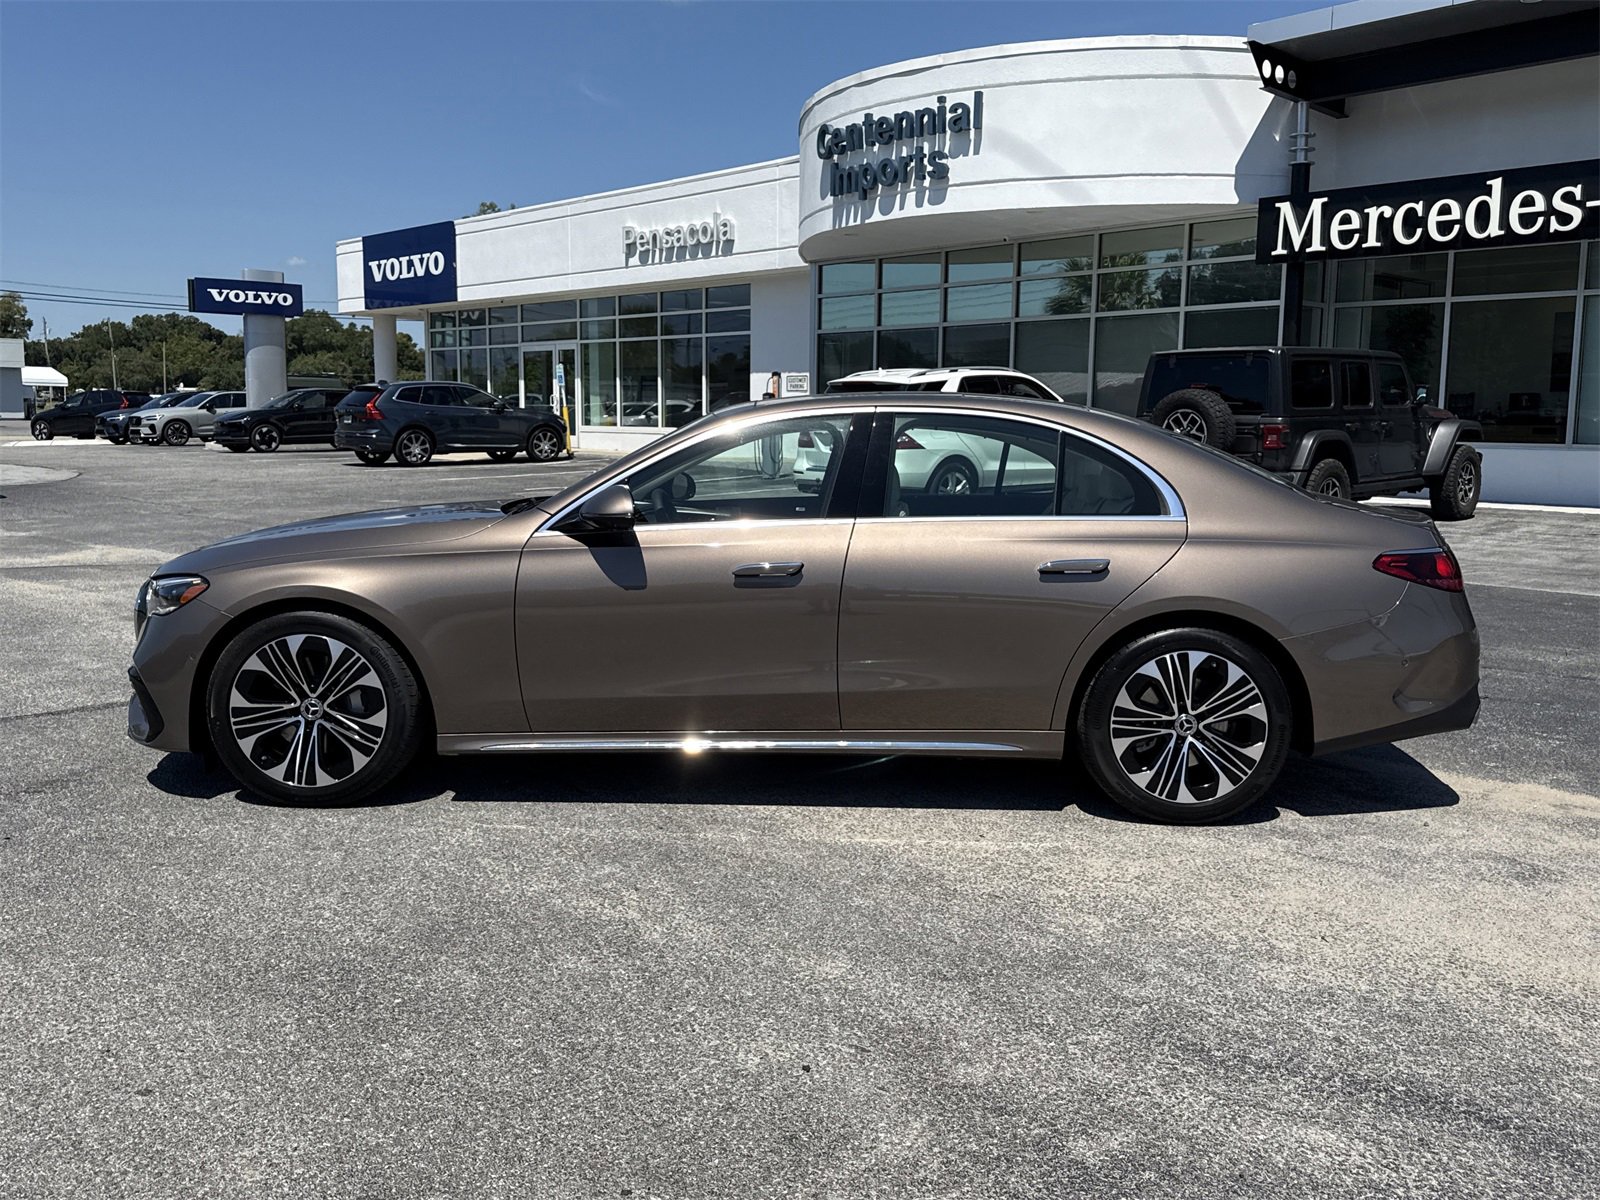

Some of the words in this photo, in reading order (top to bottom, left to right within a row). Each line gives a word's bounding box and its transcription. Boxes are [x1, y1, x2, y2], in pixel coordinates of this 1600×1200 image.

[817, 91, 984, 160] Centennial
[830, 146, 950, 200] Imports
[622, 212, 735, 254] Pensacola
[1270, 176, 1600, 256] Mercedes-
[368, 251, 445, 283] VOLVO
[206, 288, 293, 306] VOLVO
